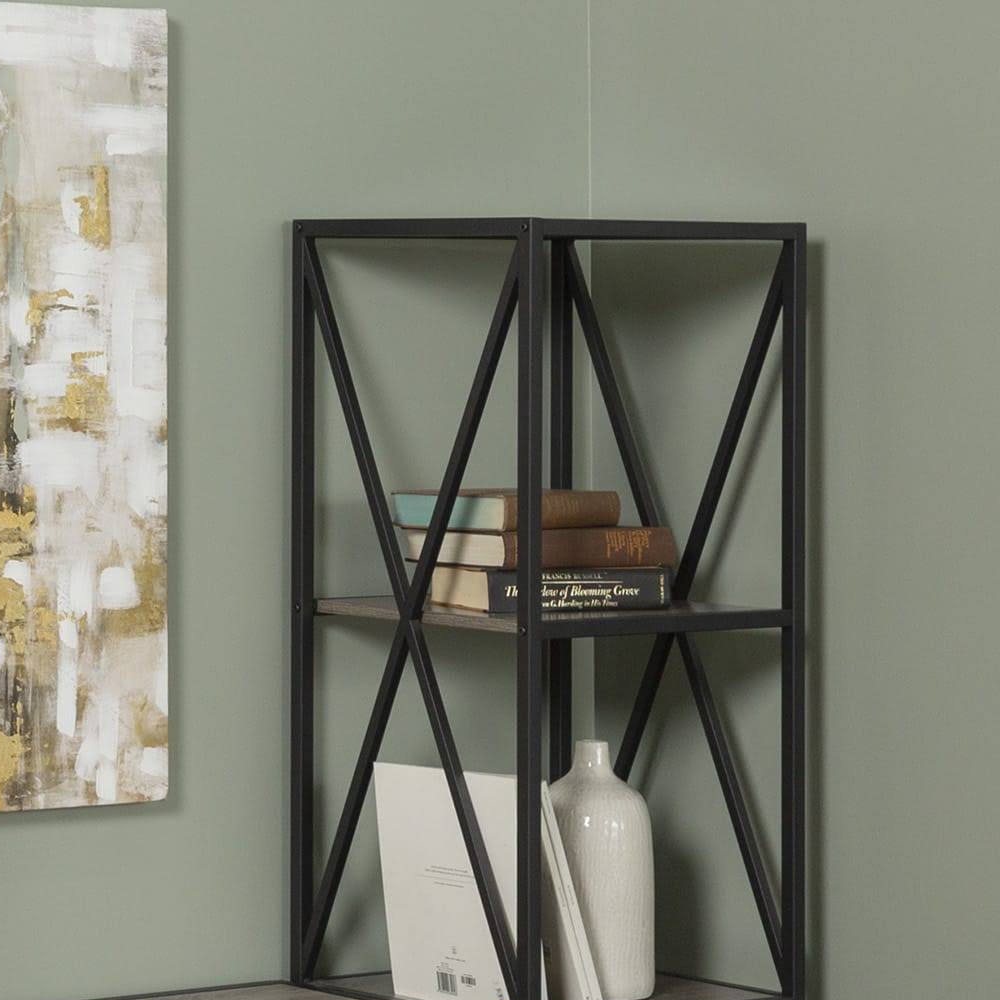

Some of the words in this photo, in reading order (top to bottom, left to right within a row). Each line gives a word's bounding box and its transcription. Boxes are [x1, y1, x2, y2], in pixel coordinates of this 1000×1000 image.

[559, 585, 570, 599] of
[570, 585, 612, 599] Blooming
[613, 585, 640, 596] Grove
